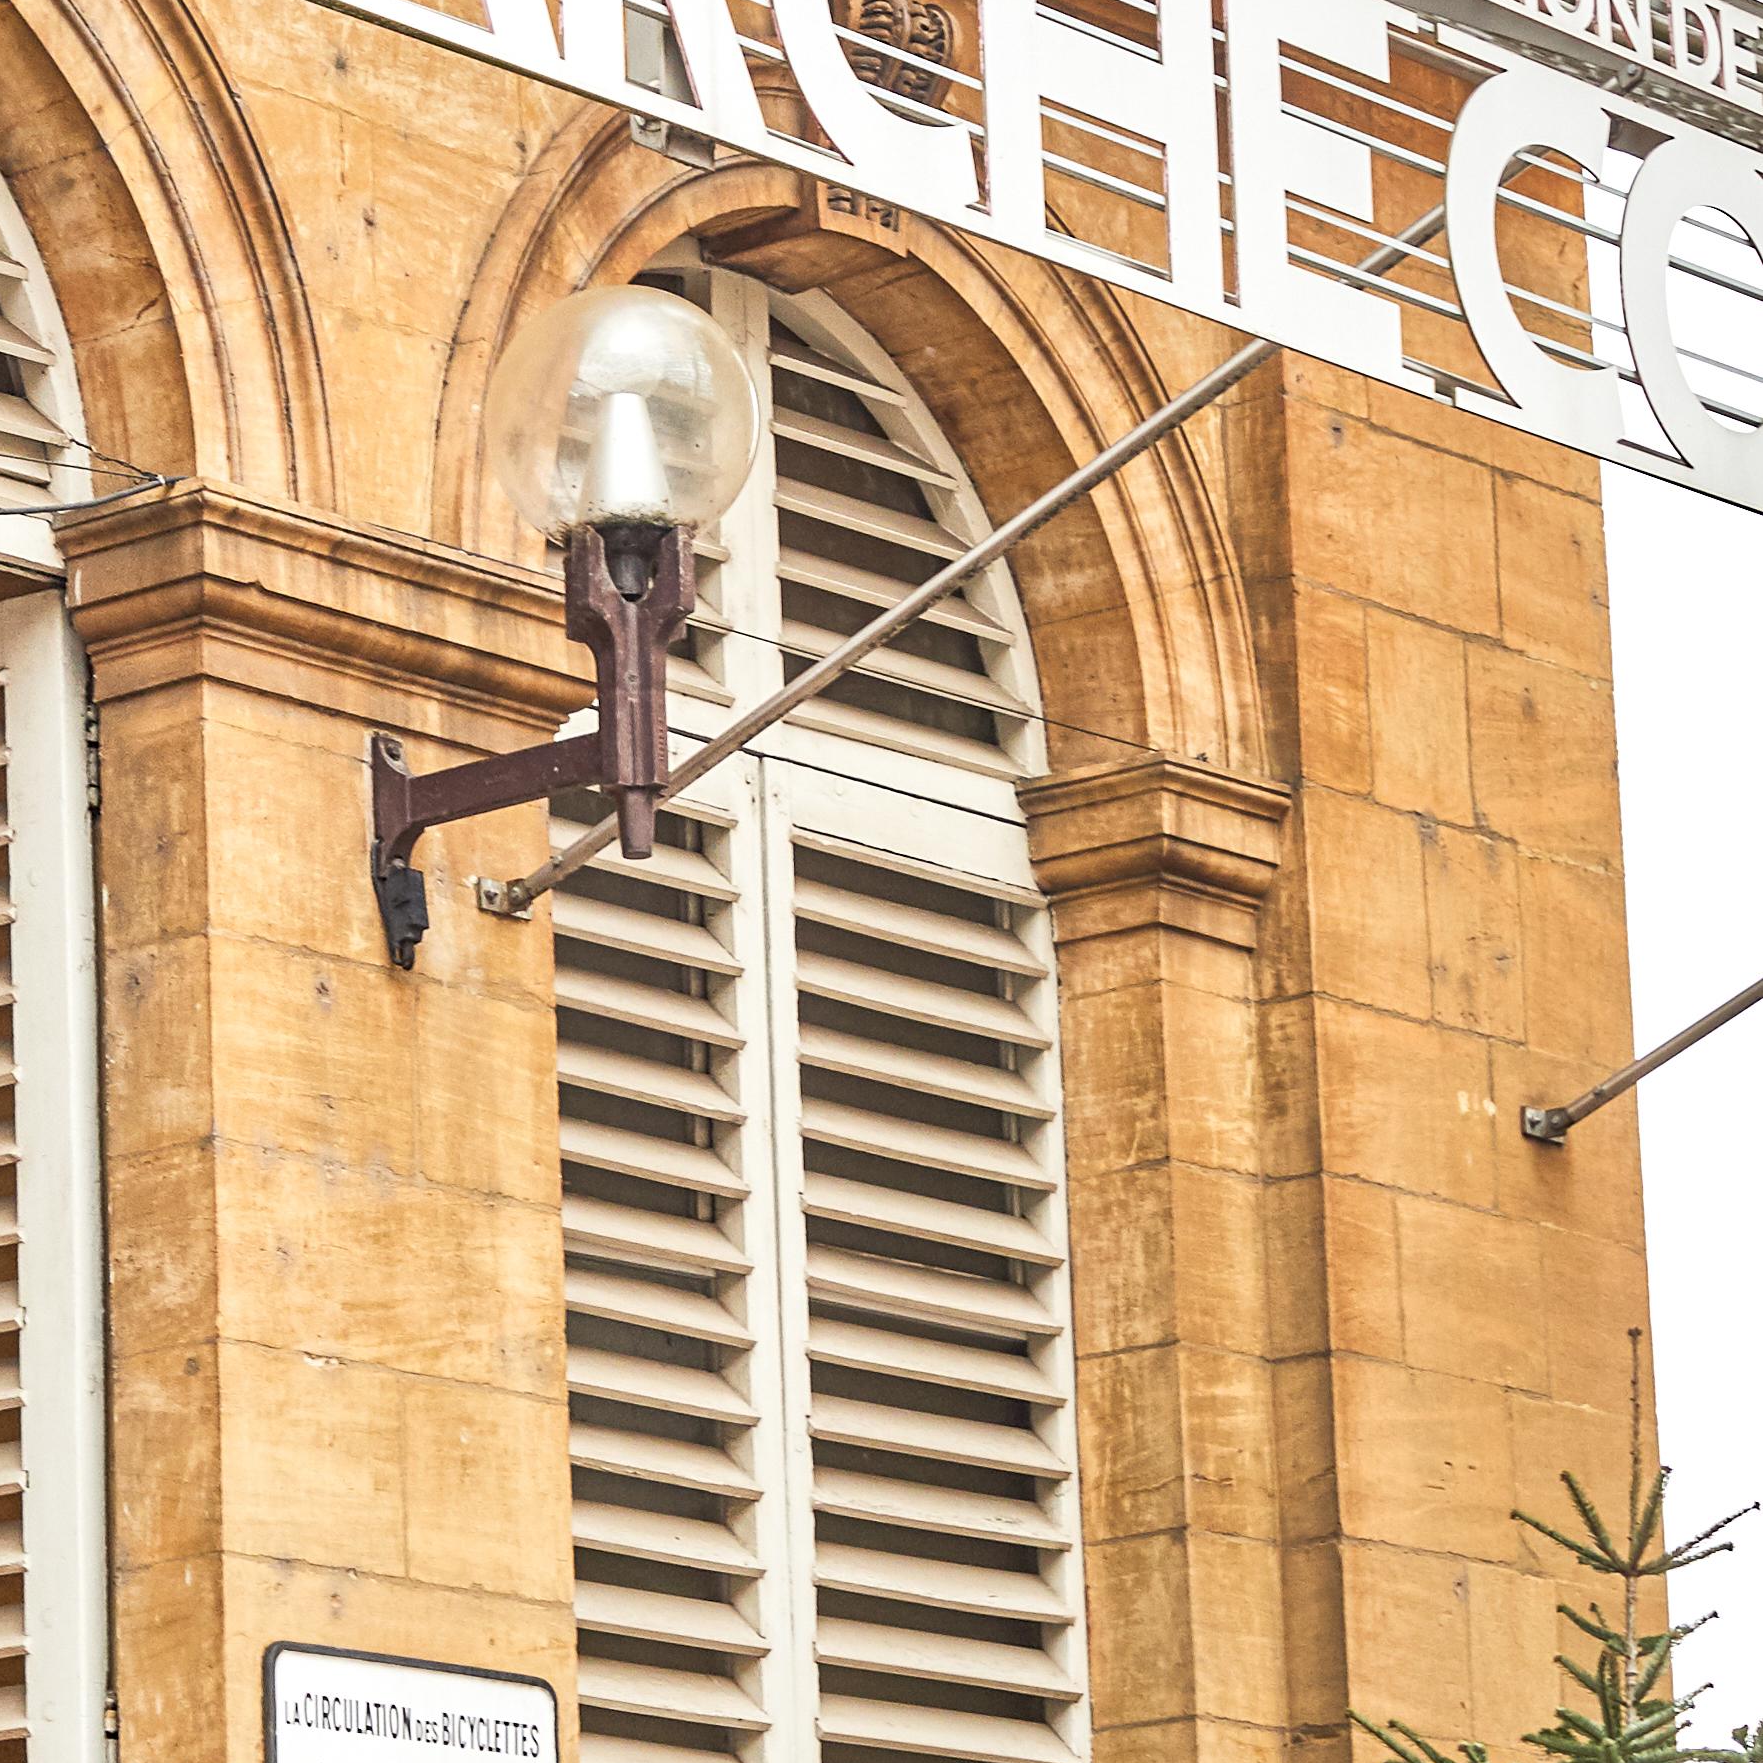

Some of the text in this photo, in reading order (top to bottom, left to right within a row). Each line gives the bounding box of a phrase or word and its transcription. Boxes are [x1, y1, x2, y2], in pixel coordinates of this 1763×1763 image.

[284, 1692, 540, 1758] LA CIRCULATION DES BICYCLETTES
